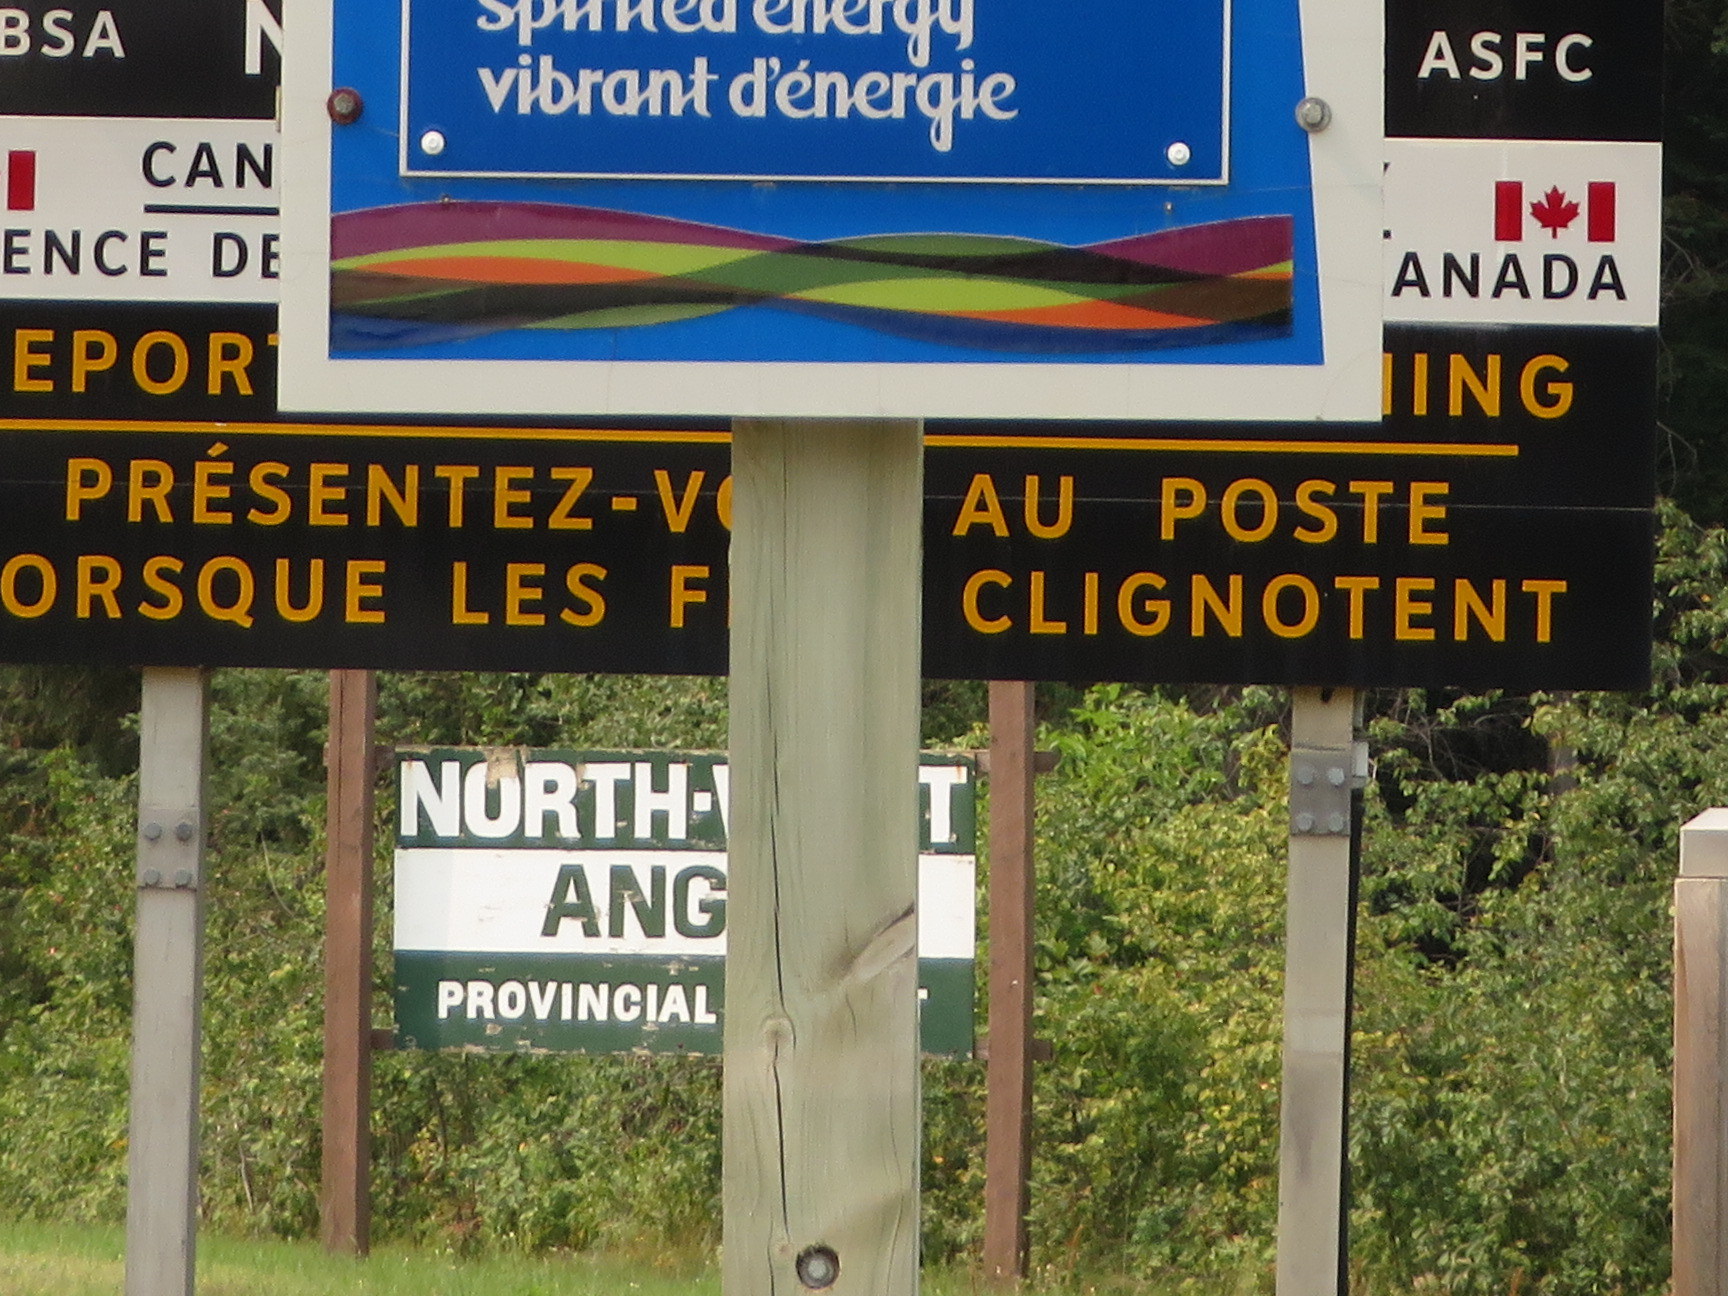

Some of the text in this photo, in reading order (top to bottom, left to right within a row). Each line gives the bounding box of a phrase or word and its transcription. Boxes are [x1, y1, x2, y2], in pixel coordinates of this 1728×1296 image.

[1417, 31, 1594, 82] ASFC
[477, 54, 1018, 152] vibrant d'énergie
[142, 140, 274, 189] CAN
[1390, 251, 1627, 301] ANADA
[1383, 352, 1574, 419] ING
[66, 443, 1450, 545] PRÉSENTEZ-V AU POSTE
[451, 561, 609, 627] LES
[962, 569, 1568, 643] CLIGNOTENT
[541, 864, 728, 939] ANG
[437, 979, 717, 1024] PROVINCIAL
